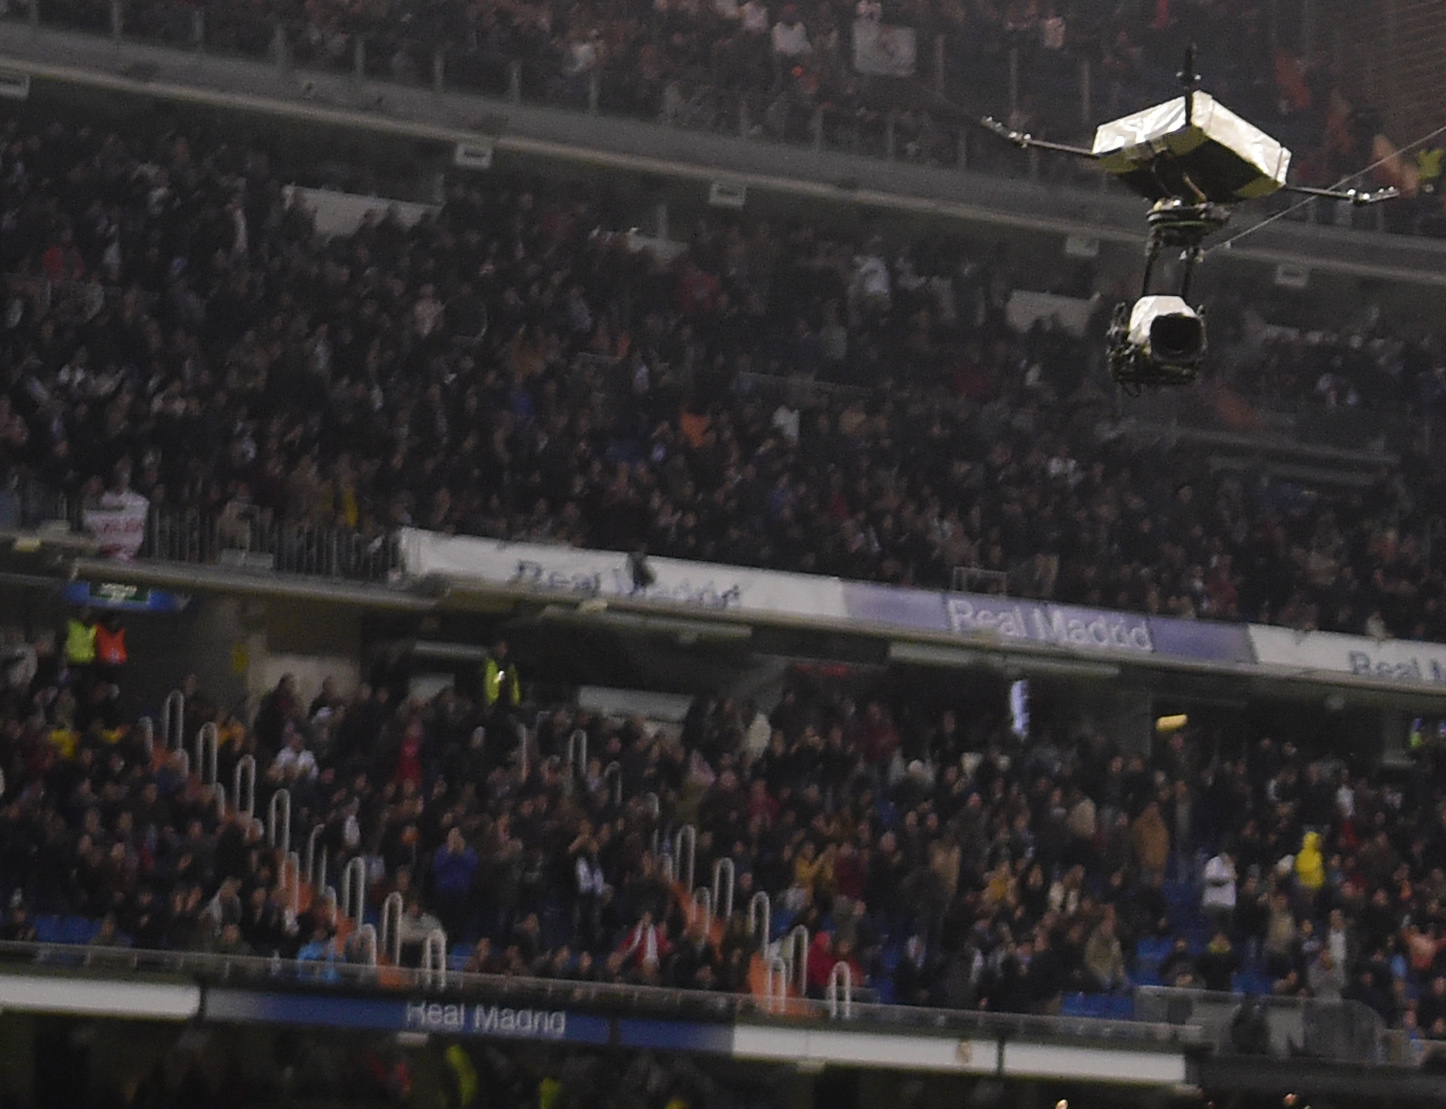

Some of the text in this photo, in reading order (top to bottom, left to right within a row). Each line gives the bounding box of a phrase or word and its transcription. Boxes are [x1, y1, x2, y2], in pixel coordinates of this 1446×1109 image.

[949, 599, 1152, 650] Real Madrid
[1349, 652, 1420, 680] Real
